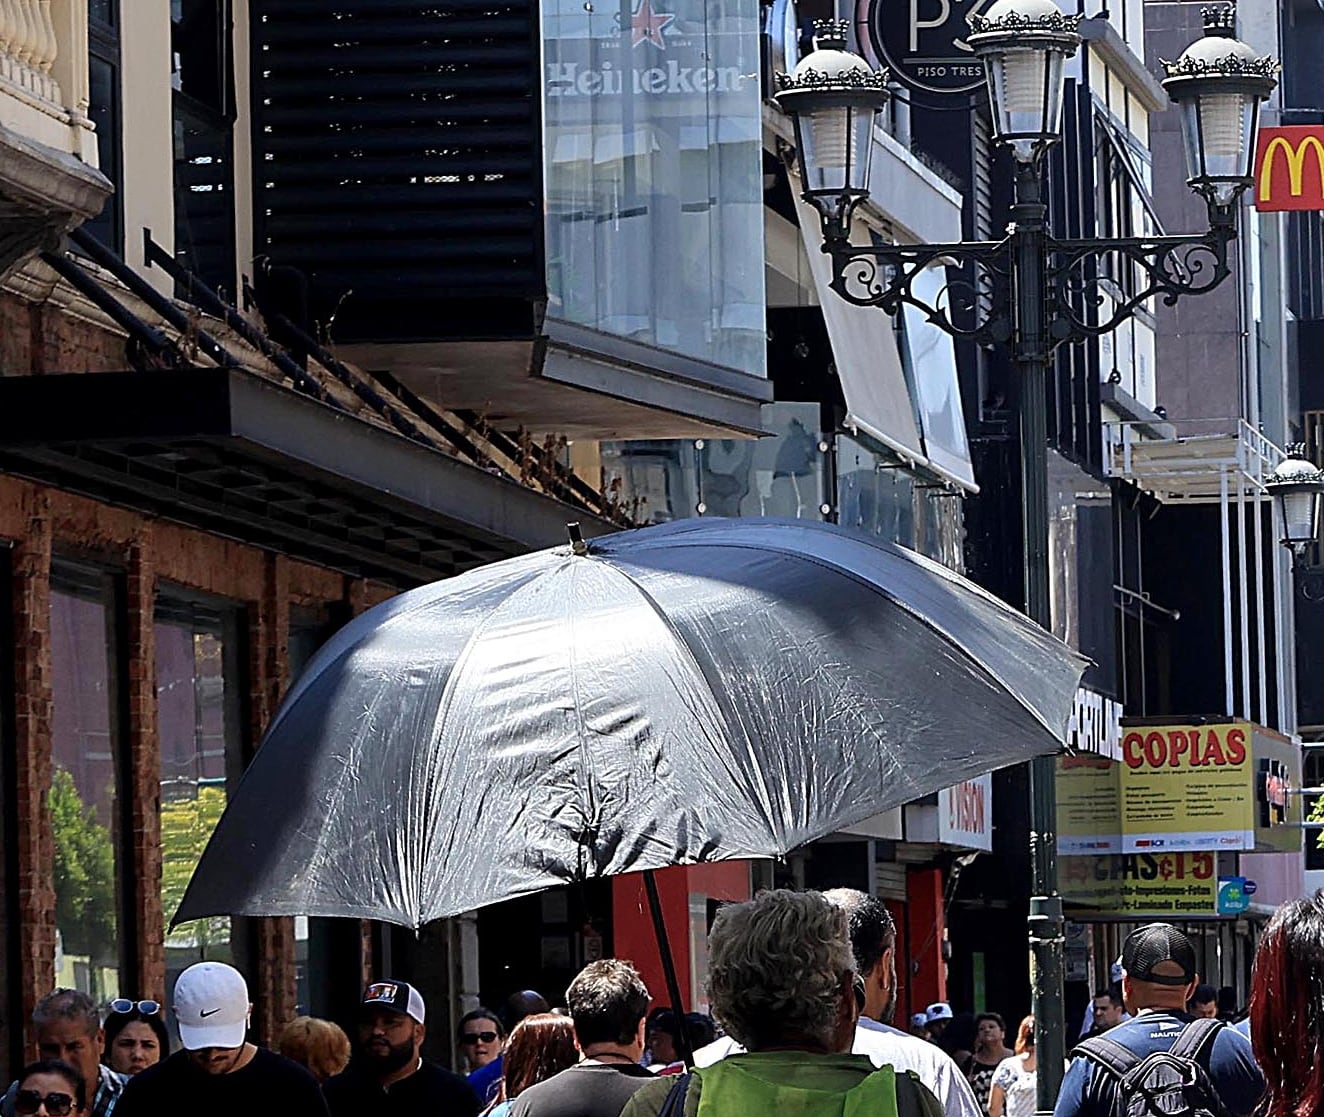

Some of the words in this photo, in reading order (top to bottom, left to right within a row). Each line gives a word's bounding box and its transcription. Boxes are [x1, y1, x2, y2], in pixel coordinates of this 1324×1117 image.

[547, 60, 746, 97] Heineken
[917, 66, 946, 77] PISO
[950, 66, 982, 76] TRES
[1123, 729, 1248, 769] COPIAS
